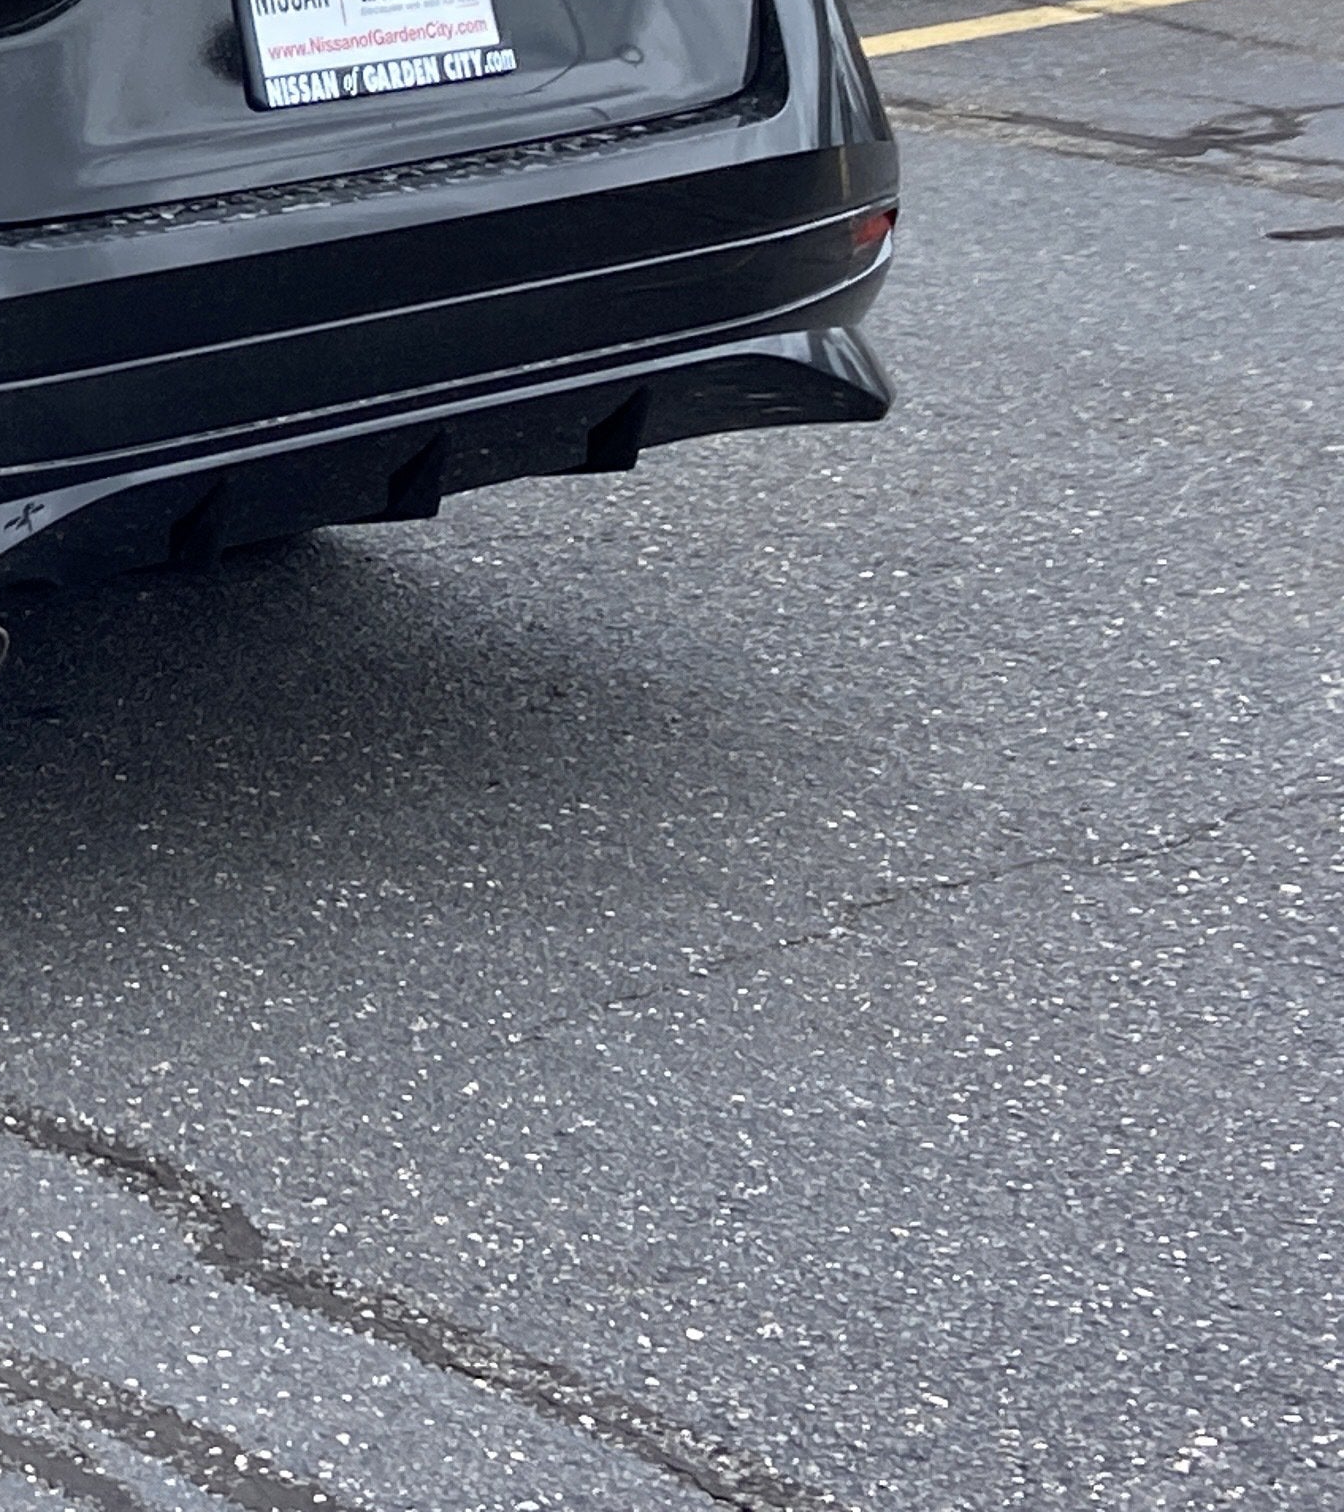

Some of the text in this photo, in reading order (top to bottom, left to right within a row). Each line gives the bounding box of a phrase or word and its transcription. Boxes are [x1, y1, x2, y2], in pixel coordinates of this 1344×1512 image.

[267, 17, 488, 61] www.NissanofGardenCity.com
[265, 48, 517, 108] NISSAN of GARDEN CITY.com
